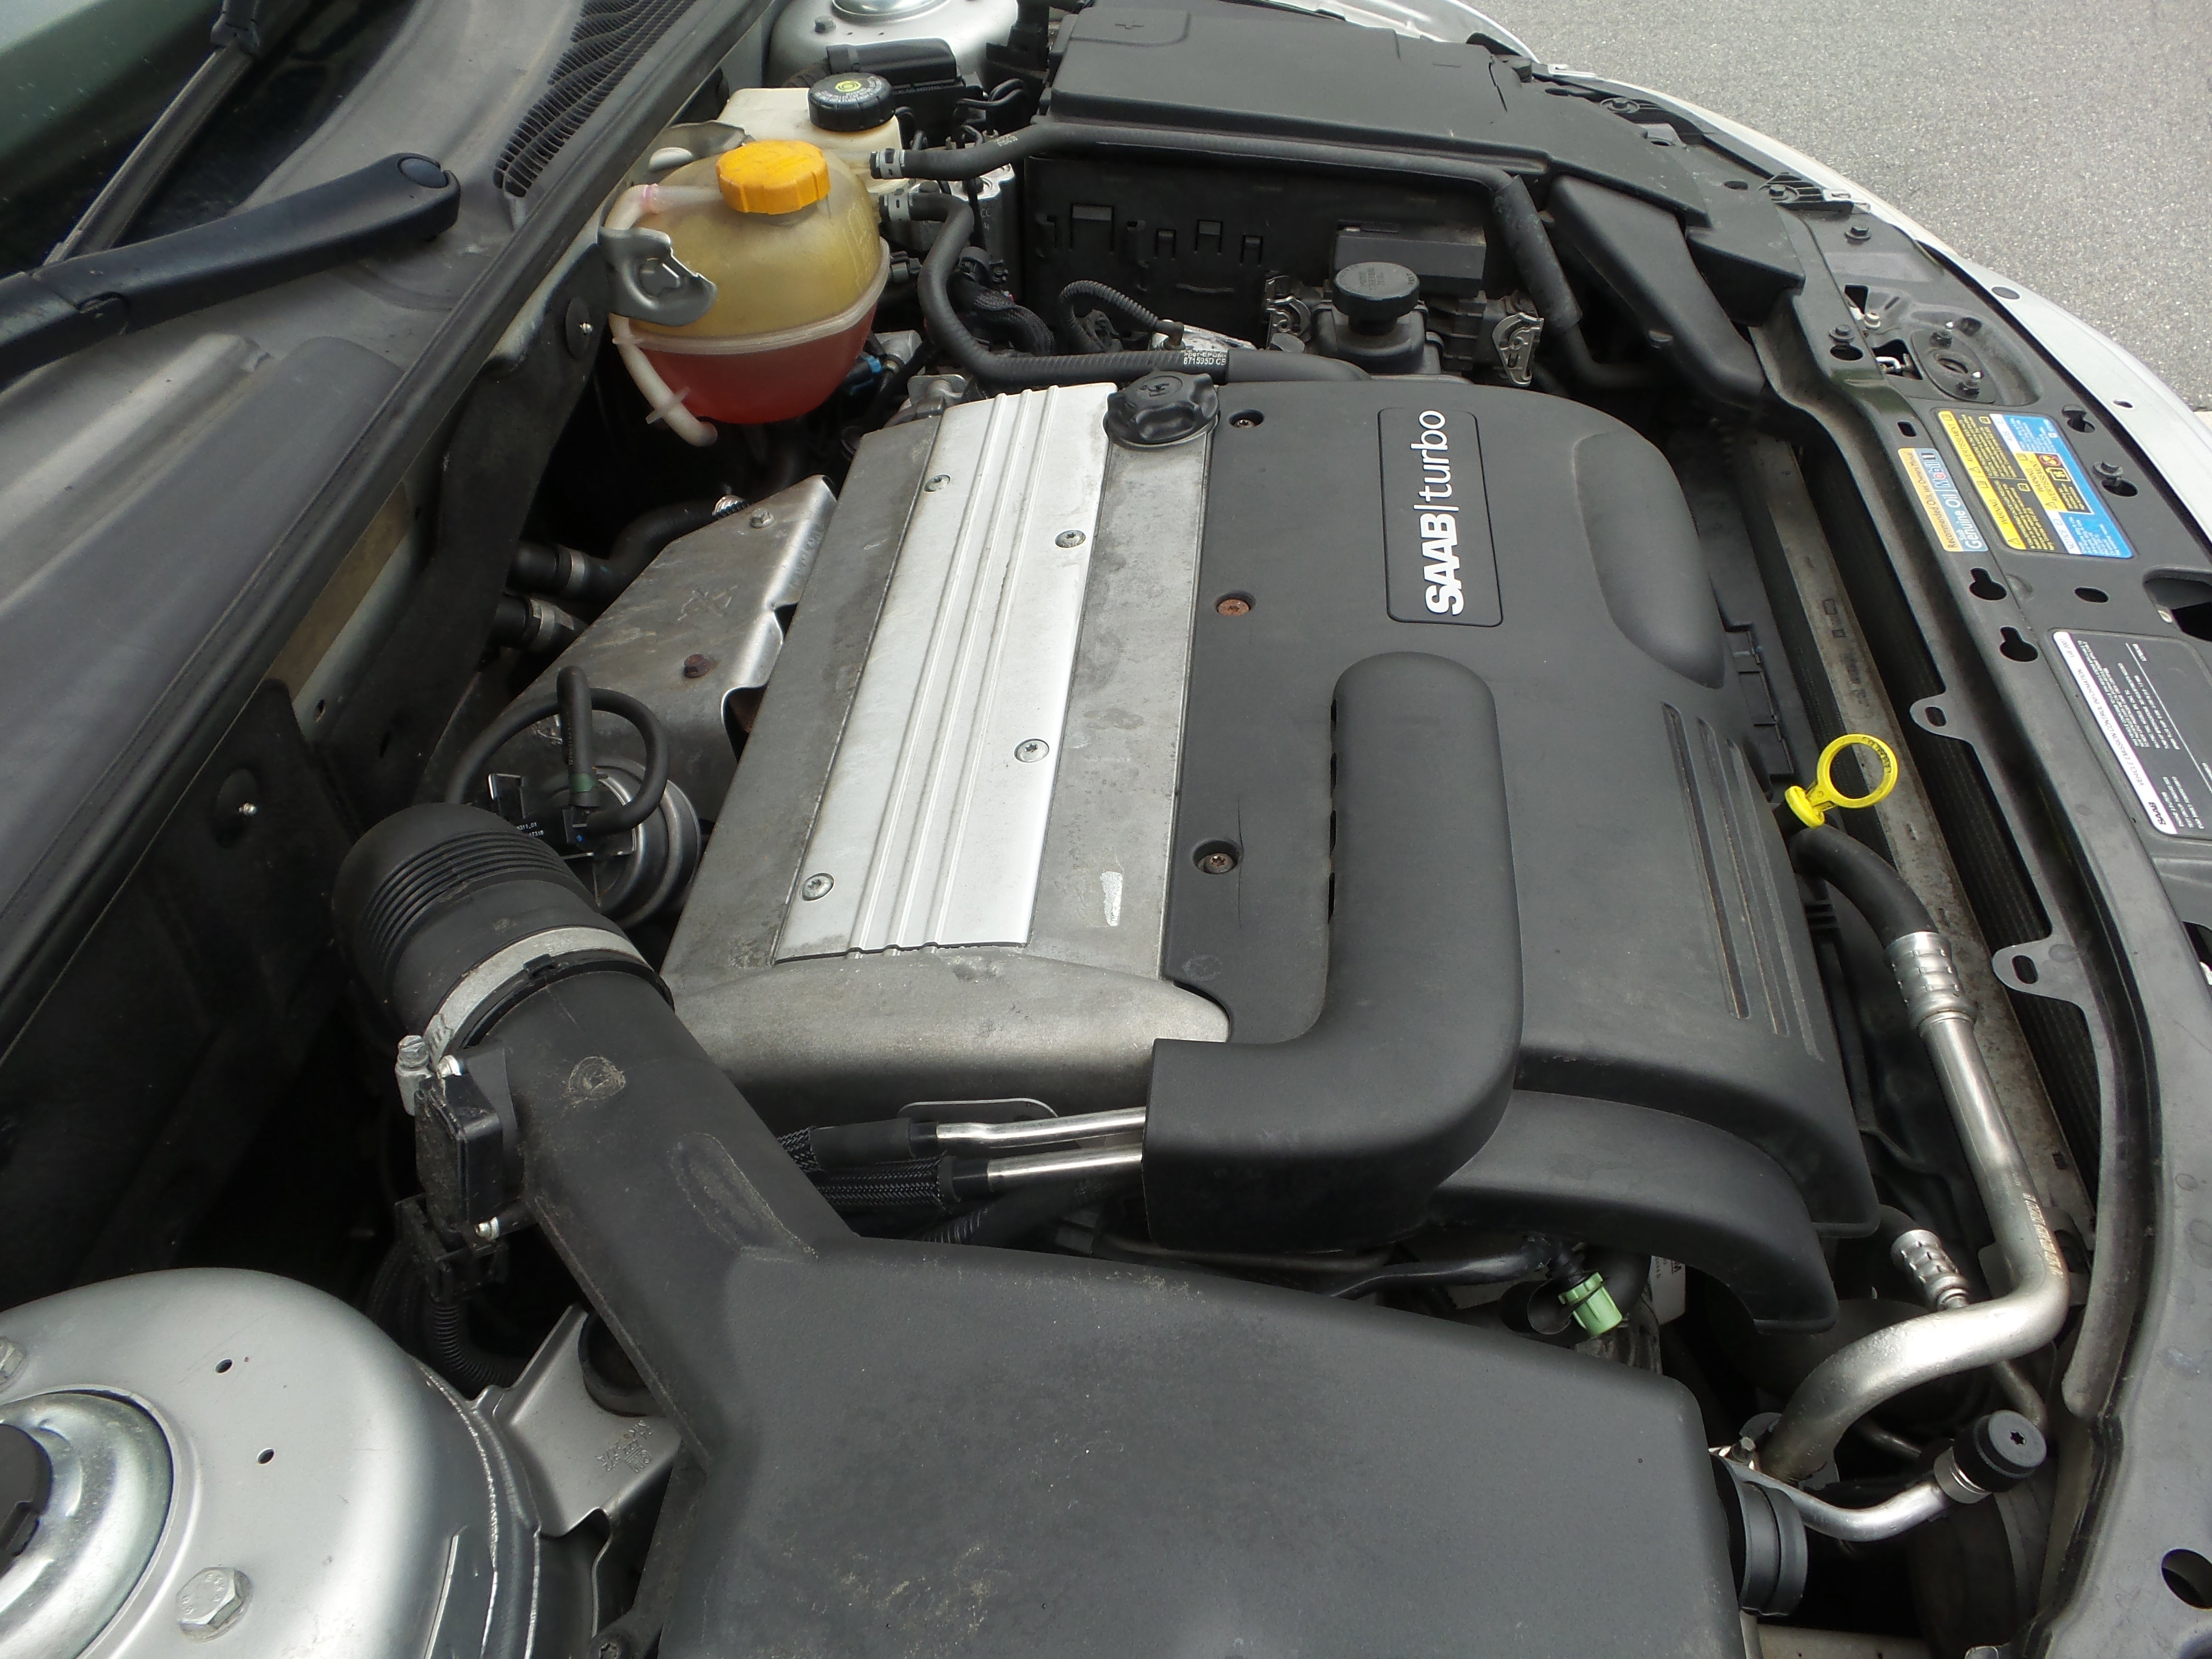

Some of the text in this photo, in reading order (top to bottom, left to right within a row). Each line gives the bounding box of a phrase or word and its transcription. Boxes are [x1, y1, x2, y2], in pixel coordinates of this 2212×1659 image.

[1923, 462, 1951, 487] Mobil
[1410, 410, 1464, 615] SAAB turbo
[1929, 507, 1958, 548] Recommended
[1941, 494, 1984, 548] Genuine Oil
[2147, 801, 2167, 825] SAAB
